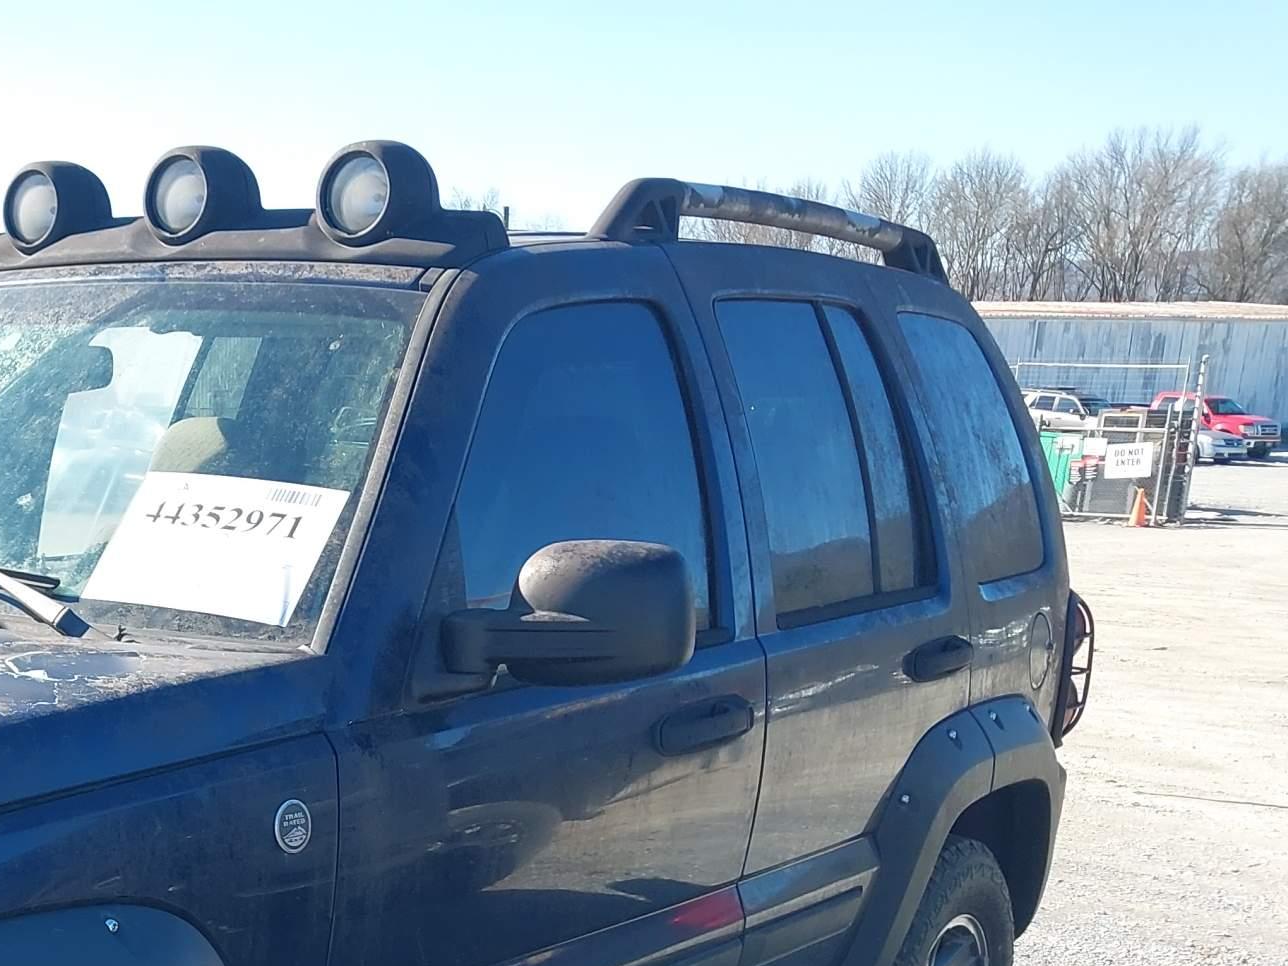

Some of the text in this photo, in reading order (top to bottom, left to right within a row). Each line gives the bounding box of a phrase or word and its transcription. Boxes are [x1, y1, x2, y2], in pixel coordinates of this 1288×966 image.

[1114, 447, 1144, 458] DO NOT
[146, 501, 303, 539] 44352971
[284, 811, 305, 821] TRAIL
[283, 818, 306, 828] RATED
